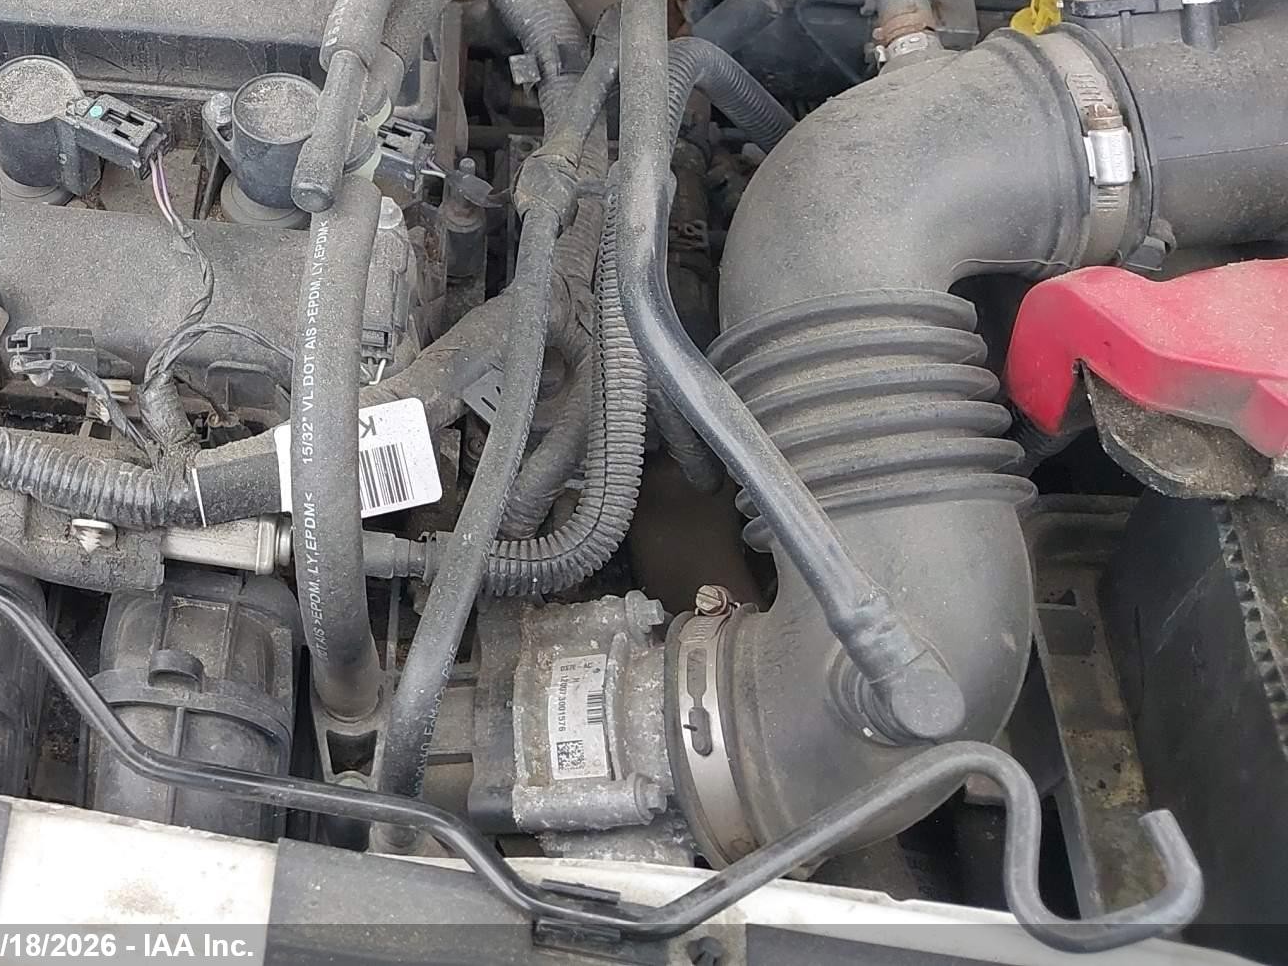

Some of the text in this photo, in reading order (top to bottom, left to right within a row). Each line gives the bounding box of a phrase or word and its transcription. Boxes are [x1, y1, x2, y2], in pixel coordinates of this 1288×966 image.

[303, 354, 314, 387] DOT
[302, 390, 314, 411] VL
[301, 416, 314, 464] 15/32"
